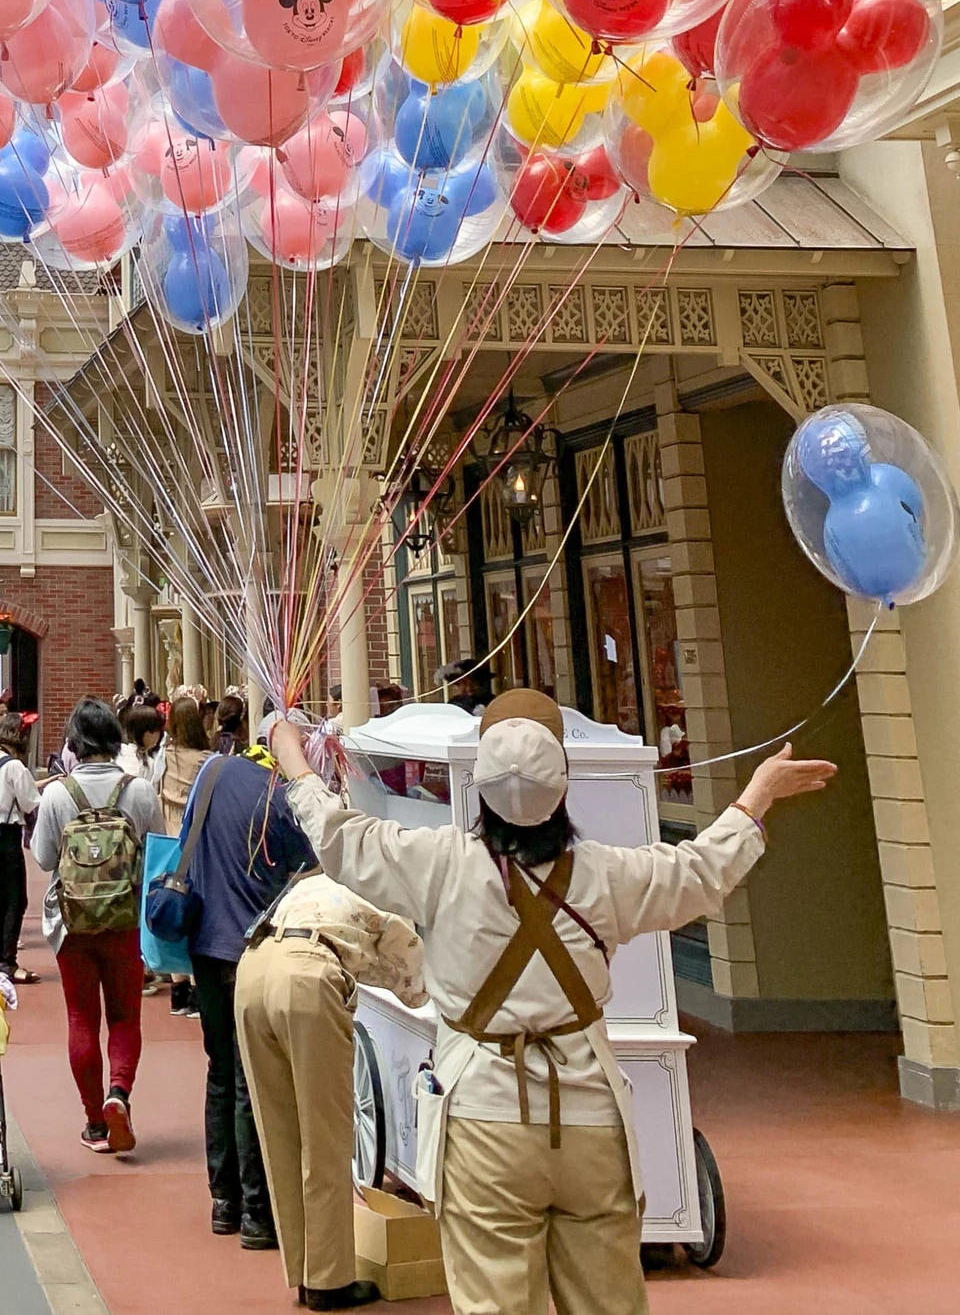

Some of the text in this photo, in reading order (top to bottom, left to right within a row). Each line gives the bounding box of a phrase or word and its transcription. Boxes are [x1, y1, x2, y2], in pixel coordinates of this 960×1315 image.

[283, 22, 299, 40] TOKYO
[299, 33, 323, 44] Disney
[571, 728, 589, 739] Co.
